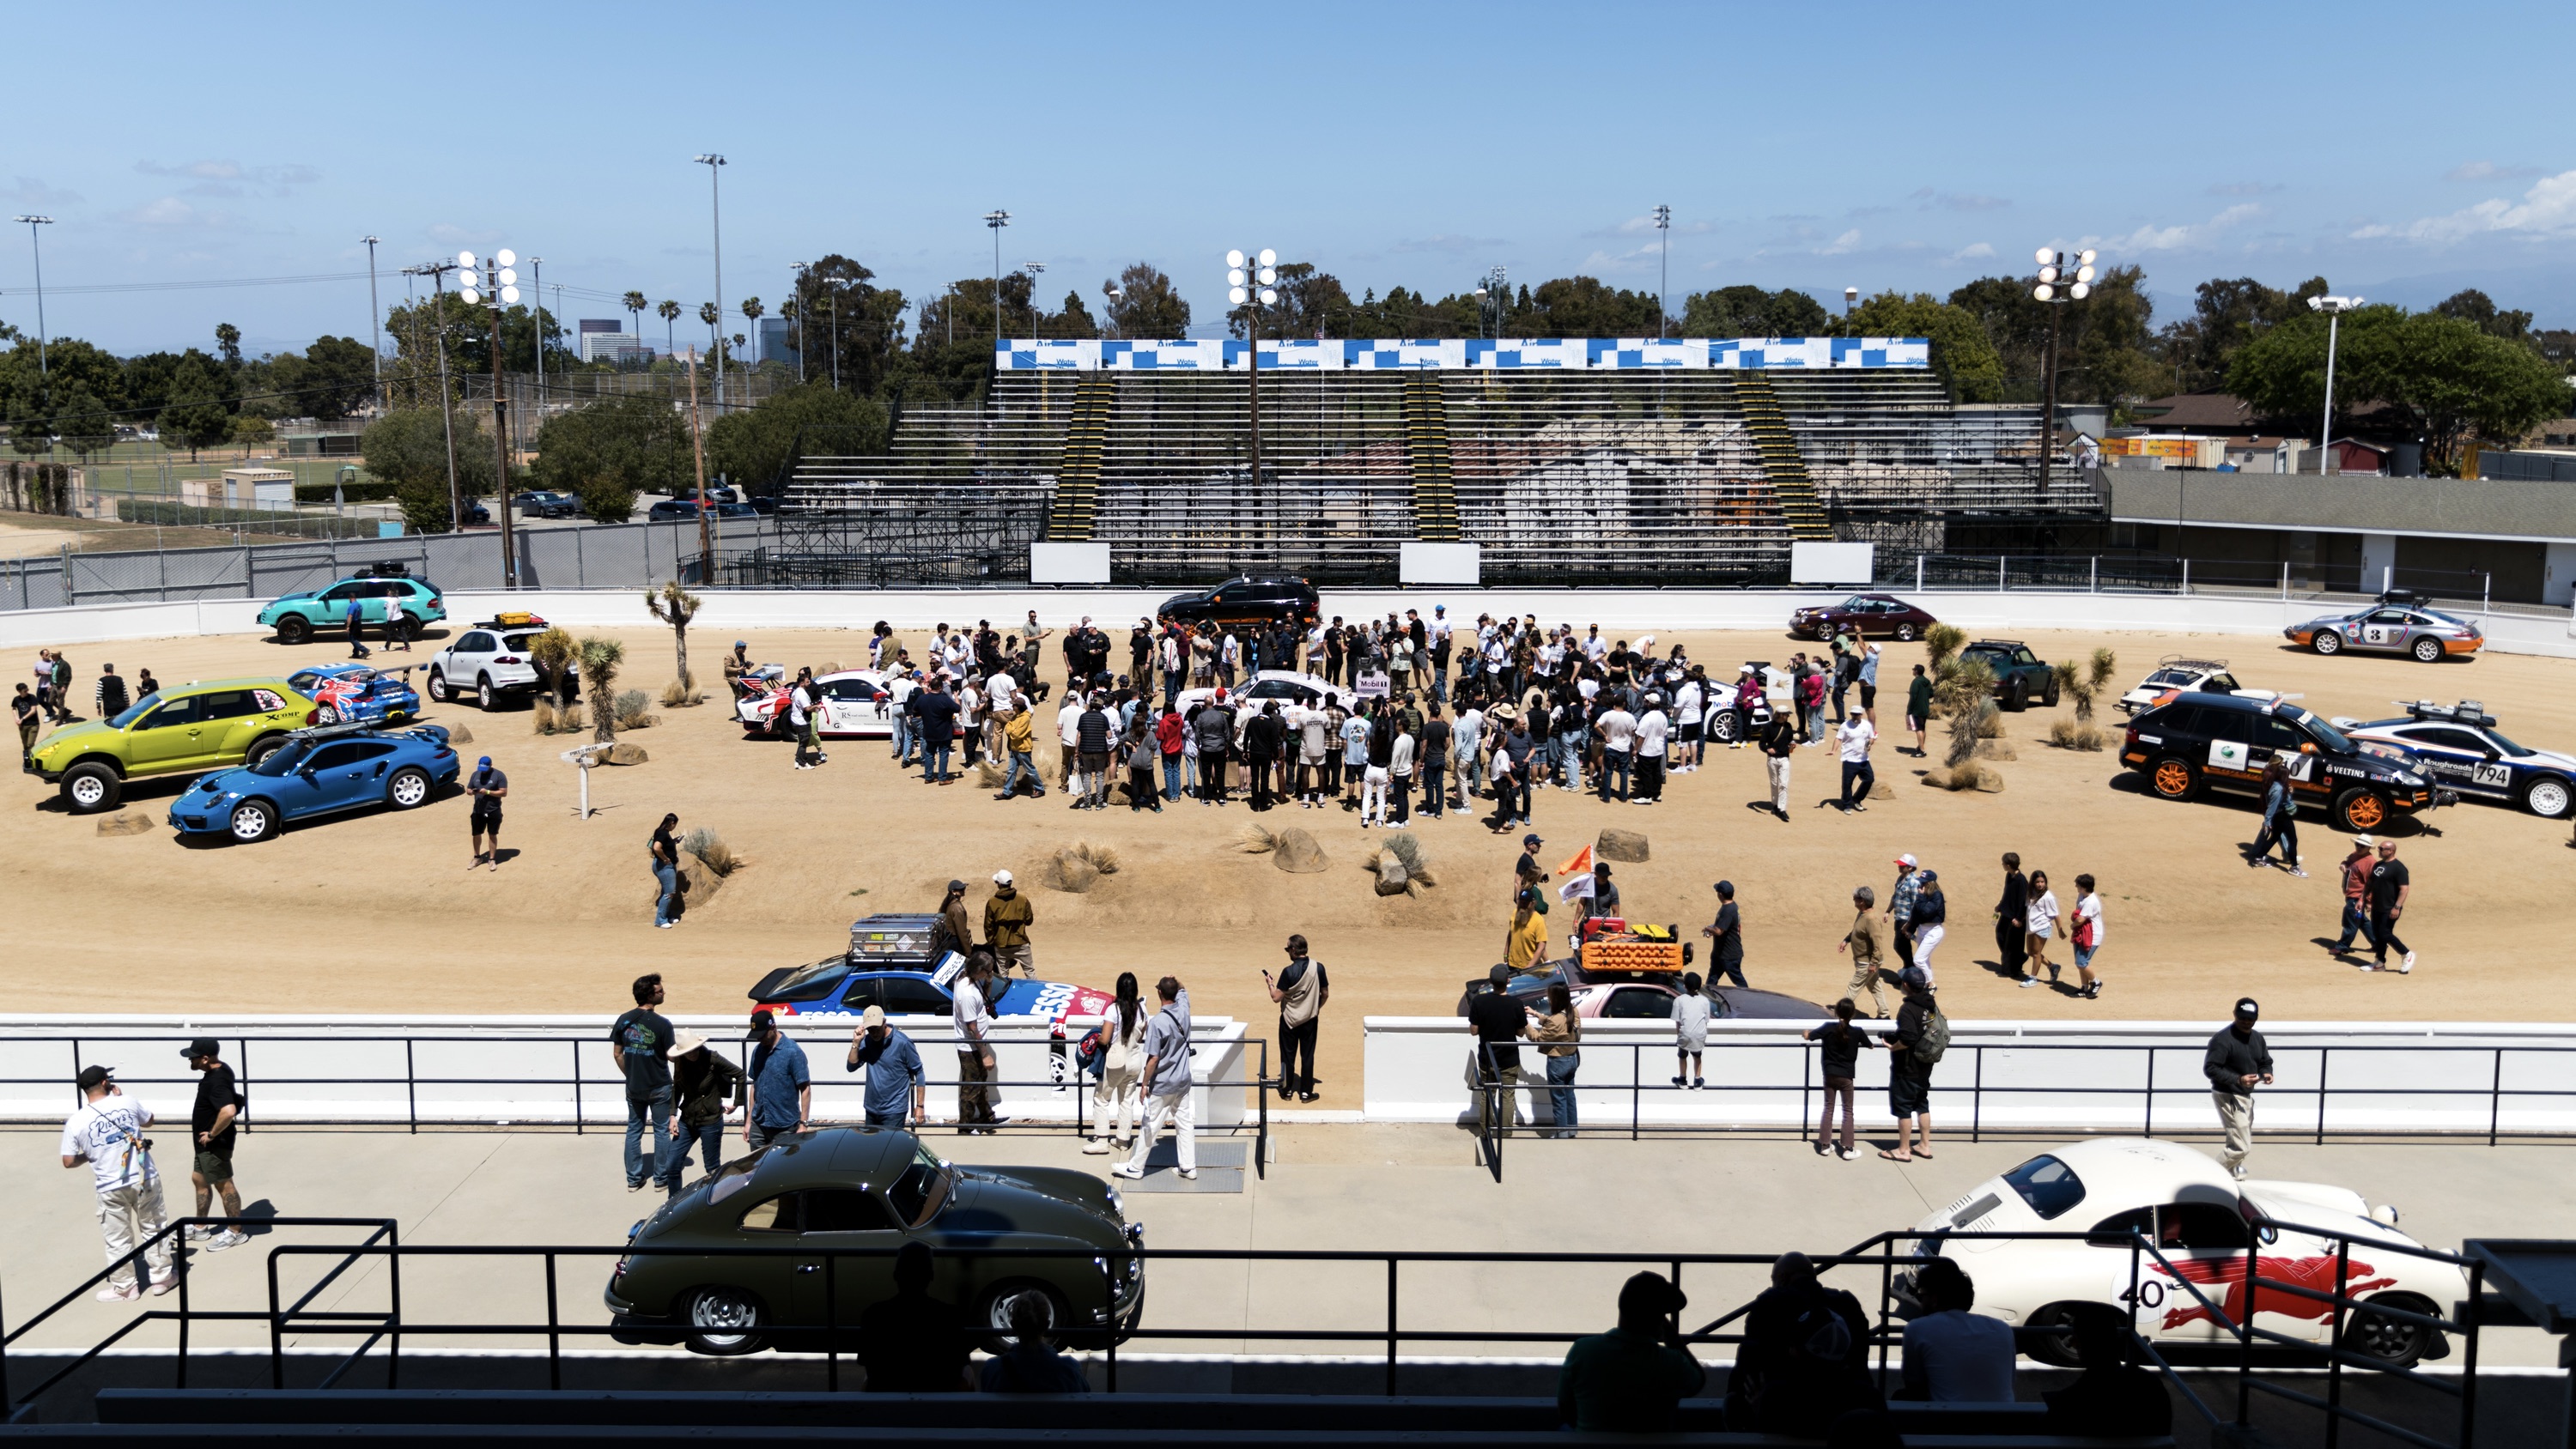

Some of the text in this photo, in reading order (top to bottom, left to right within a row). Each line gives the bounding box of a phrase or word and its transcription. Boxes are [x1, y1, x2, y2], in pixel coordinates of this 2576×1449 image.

[2370, 629, 2381, 640] 3
[874, 706, 890, 720] 11
[2333, 766, 2365, 778] VELTINS
[2423, 758, 2473, 772] Roughroads
[2476, 766, 2506, 785] 794
[1030, 982, 1079, 1019] ESSO
